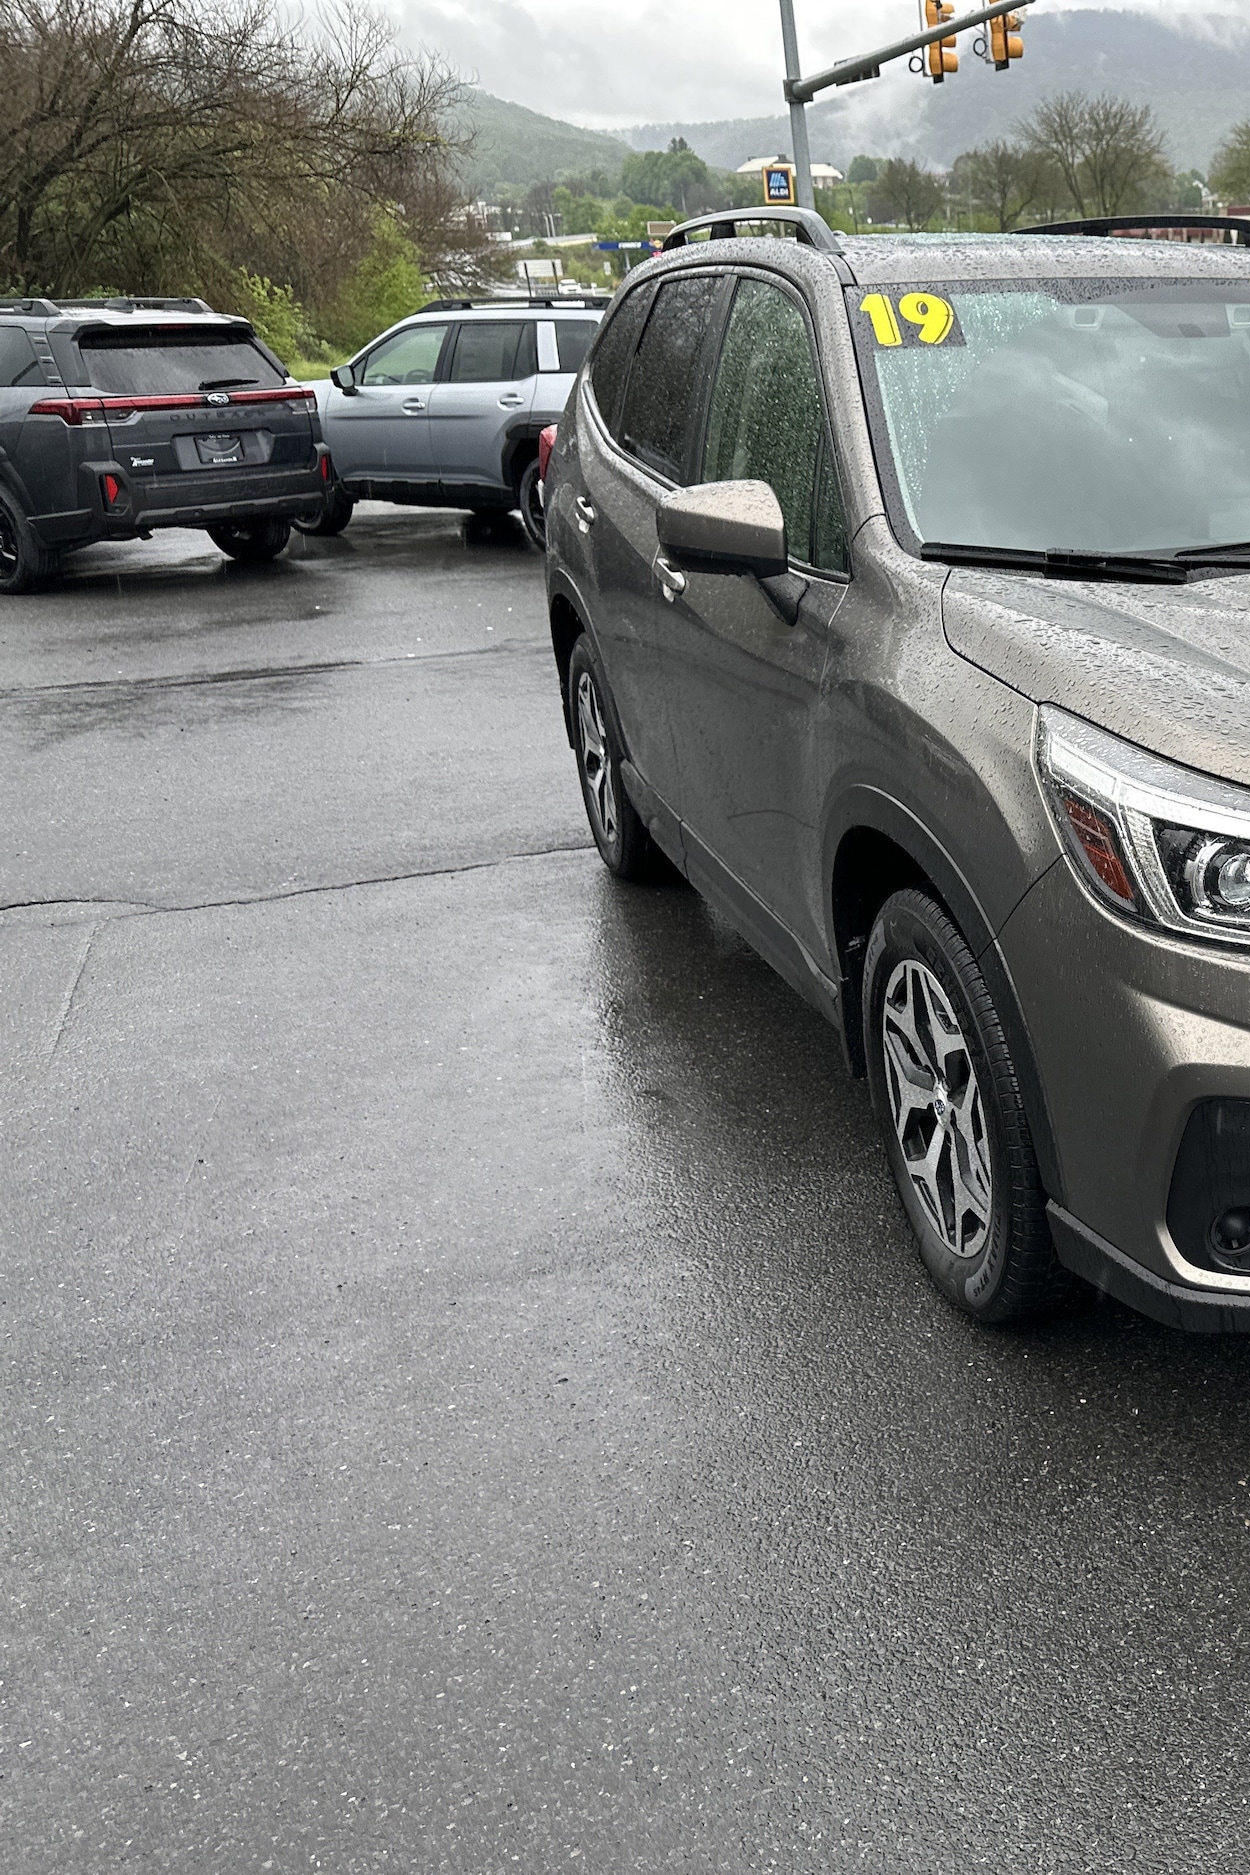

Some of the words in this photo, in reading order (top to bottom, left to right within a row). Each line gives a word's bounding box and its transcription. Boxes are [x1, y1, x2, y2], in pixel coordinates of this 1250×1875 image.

[770, 187, 789, 196] ALDI
[860, 292, 954, 346] 19
[170, 409, 266, 422] OUTBACK
